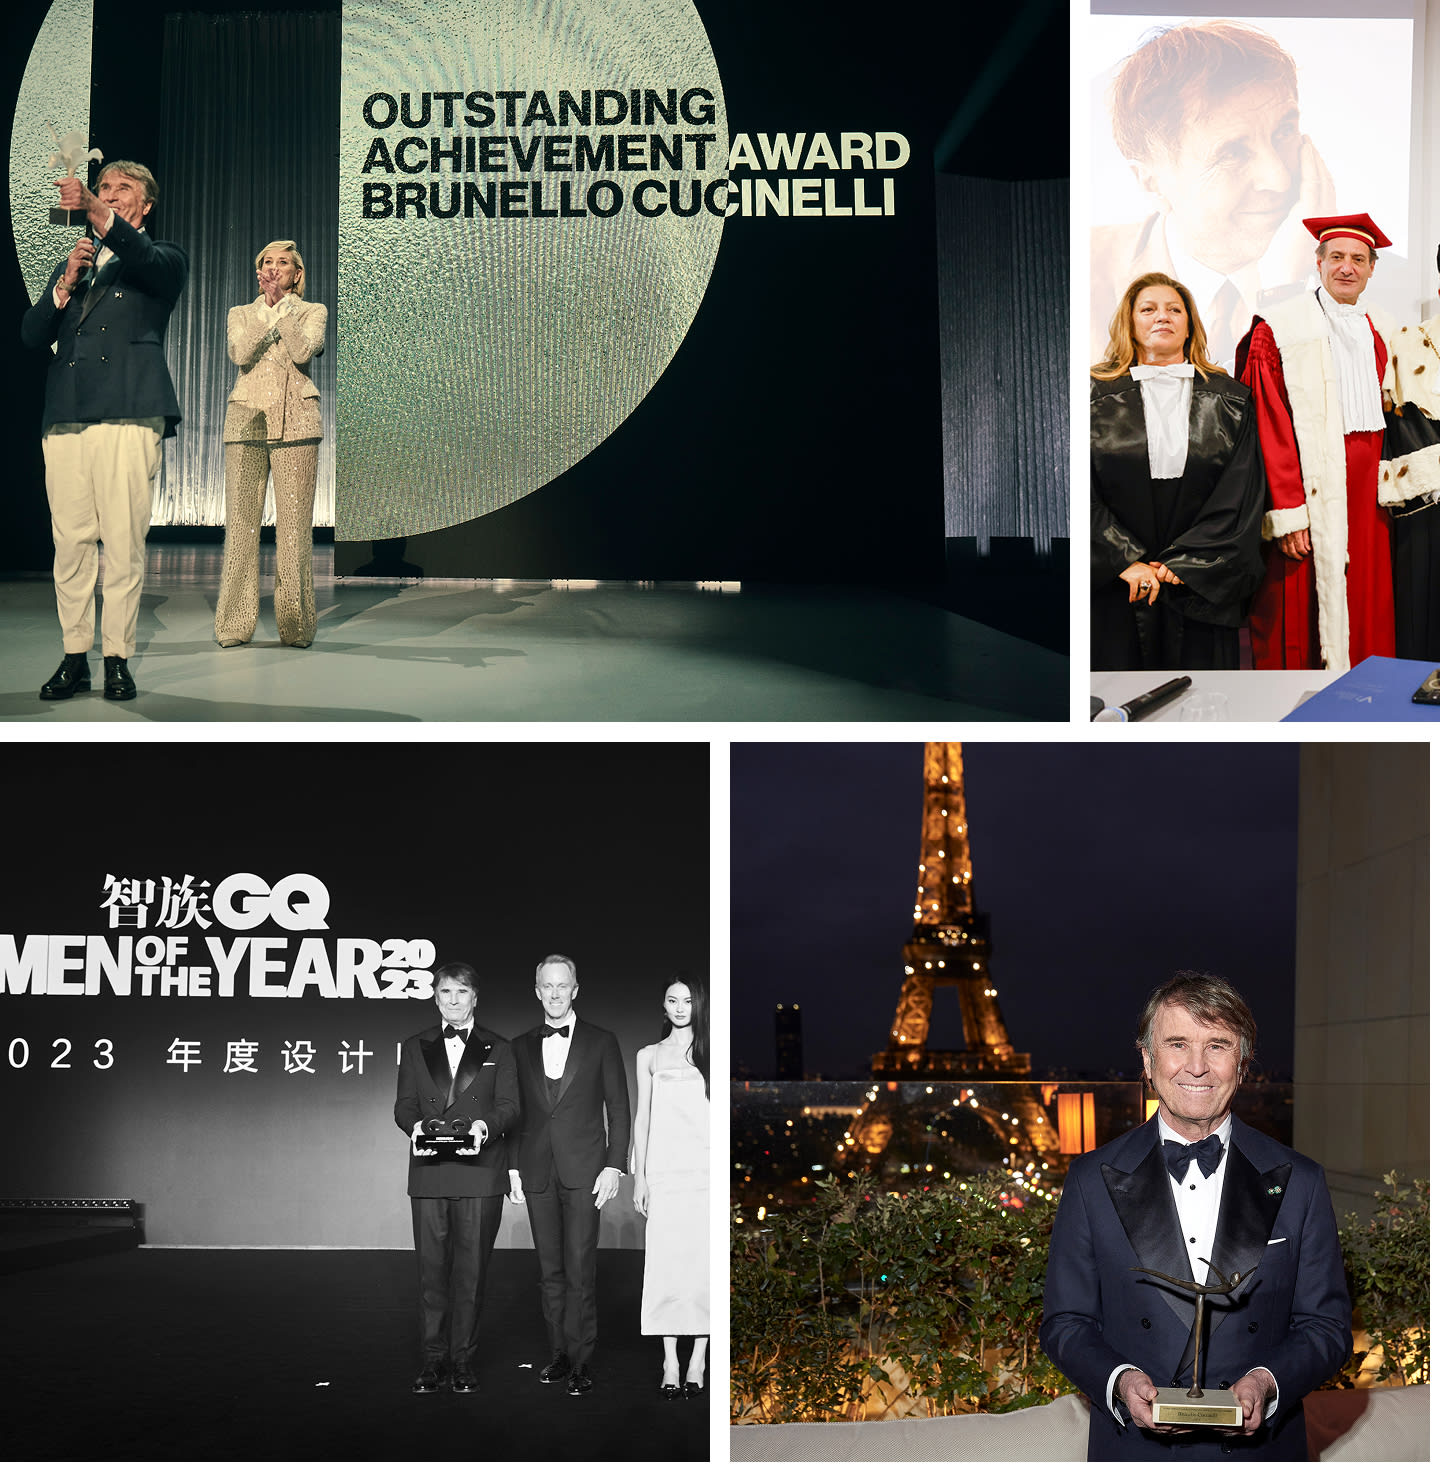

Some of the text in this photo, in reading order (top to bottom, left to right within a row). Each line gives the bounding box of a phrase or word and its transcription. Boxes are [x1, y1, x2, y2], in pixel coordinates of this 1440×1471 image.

[362, 89, 716, 129] OUTSTANDING
[362, 132, 911, 173] ACHIEVEMENT AWARD
[362, 178, 895, 219] BRUNELLO CUCINELLI
[0, 934, 133, 996] MEN
[135, 935, 189, 966] OF
[205, 936, 383, 999] YEAR
[135, 966, 211, 997] THE
[166, 1037, 402, 1075] 年度设计
